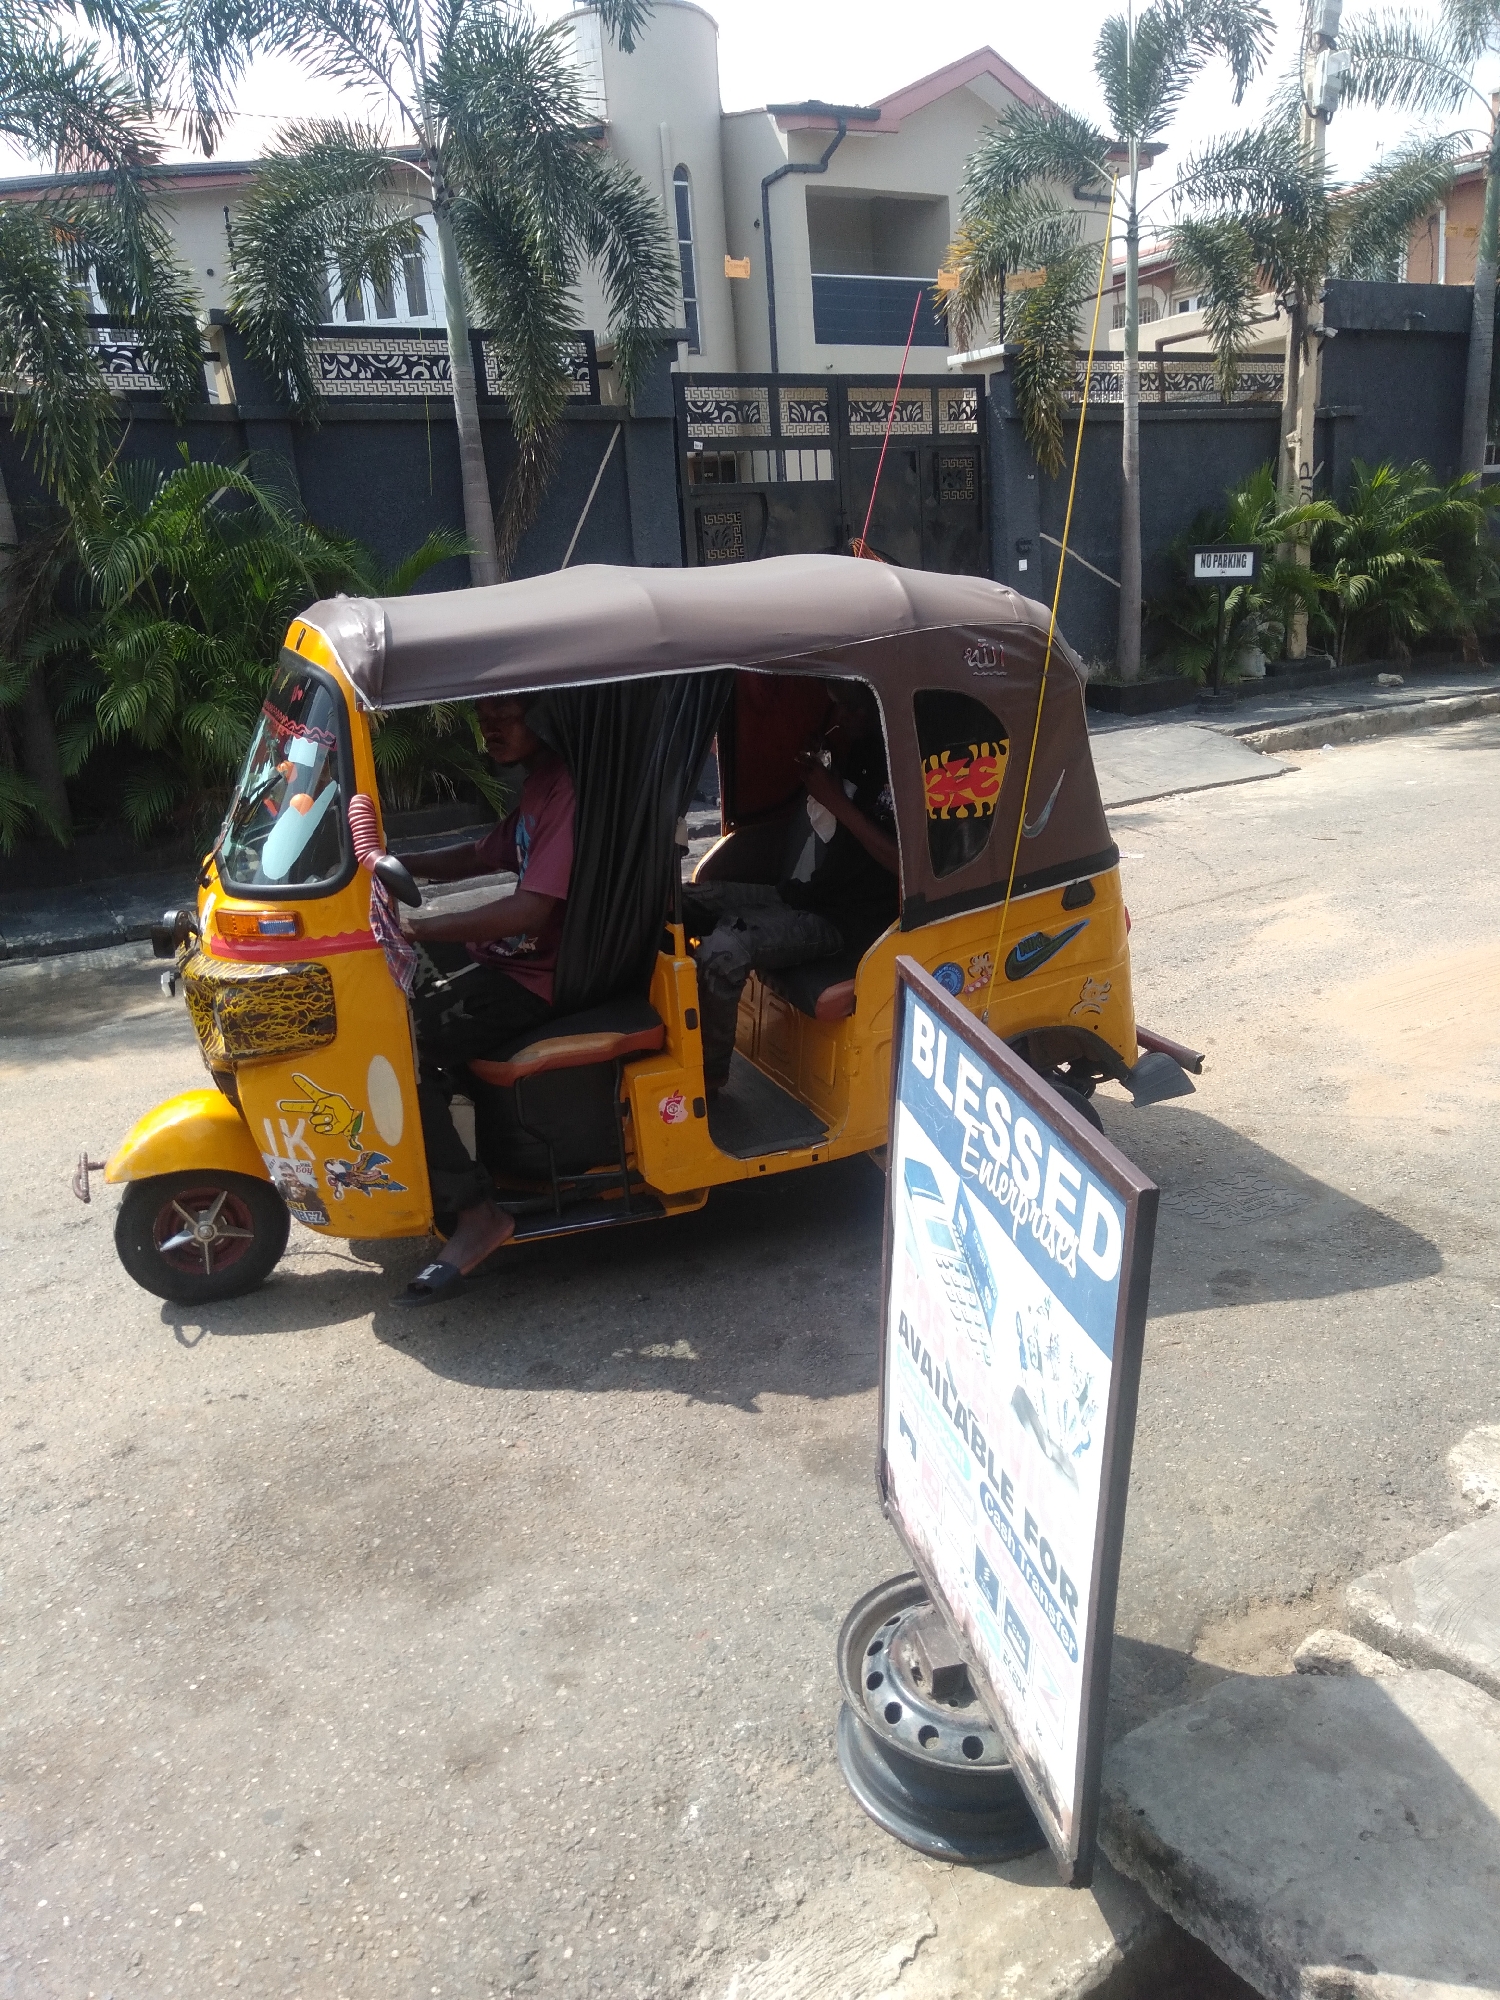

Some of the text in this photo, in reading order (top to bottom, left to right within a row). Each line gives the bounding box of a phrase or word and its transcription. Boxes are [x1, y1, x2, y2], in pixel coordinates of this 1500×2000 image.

[1200, 553, 1248, 568] NO PARKING
[911, 1004, 1122, 1282] BLESSED
[960, 1124, 1079, 1278] Enterprises
[898, 1309, 1014, 1517] AVAILABLE
[1023, 1506, 1079, 1624] FOR
[983, 1488, 1016, 1557] Cash
[1017, 1543, 1076, 1659] Transfer
